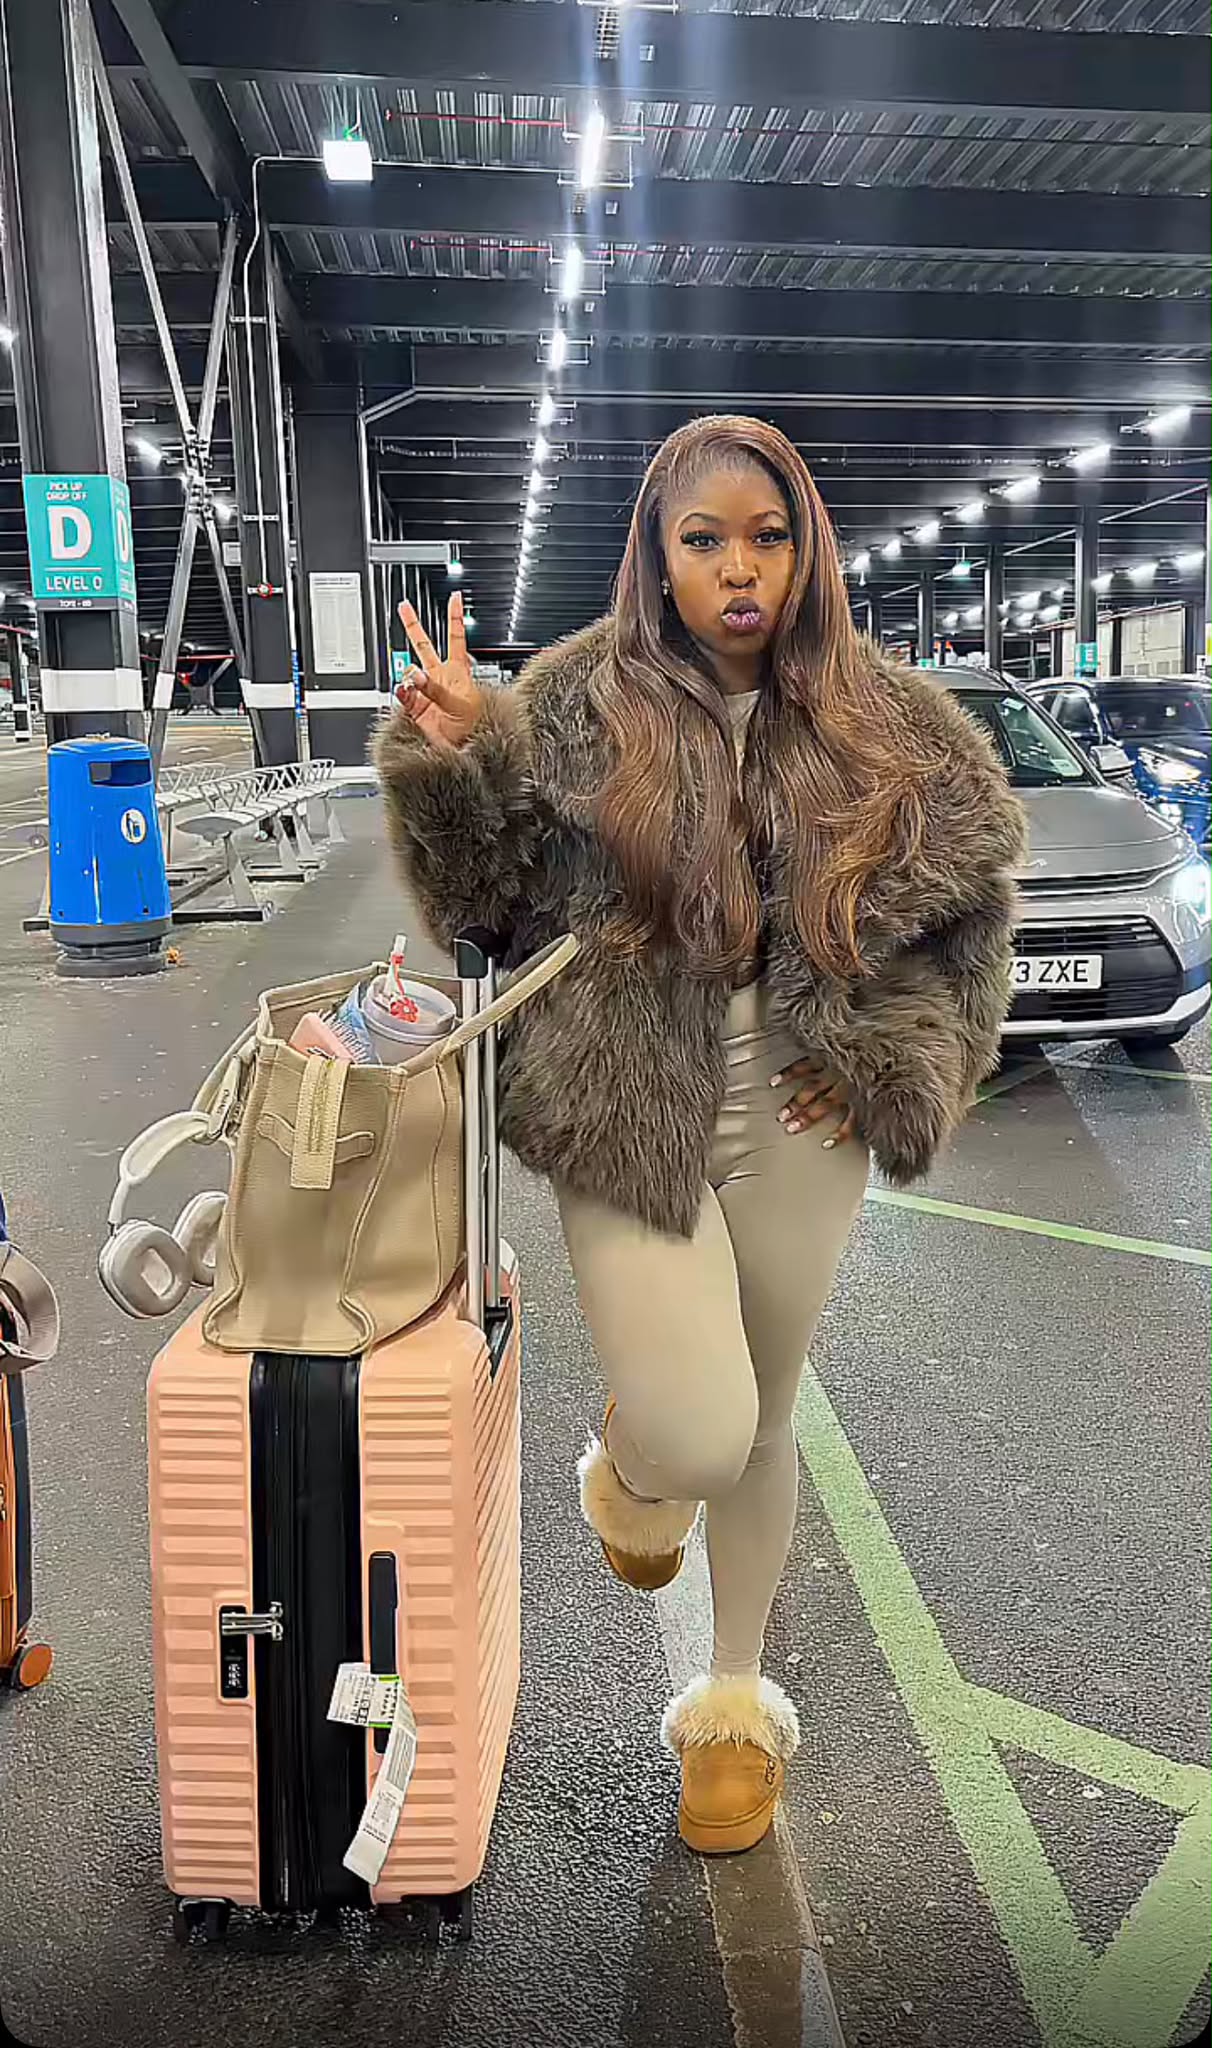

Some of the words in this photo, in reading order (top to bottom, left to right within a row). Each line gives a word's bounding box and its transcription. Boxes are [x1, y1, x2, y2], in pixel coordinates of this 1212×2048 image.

[71, 481, 83, 490] UP
[46, 491, 70, 500] DROP
[71, 491, 87, 500] OFF
[47, 505, 92, 559] D
[46, 576, 89, 591] LEVEL
[1086, 649, 1094, 661] E
[1038, 960, 1089, 983] ZXE
